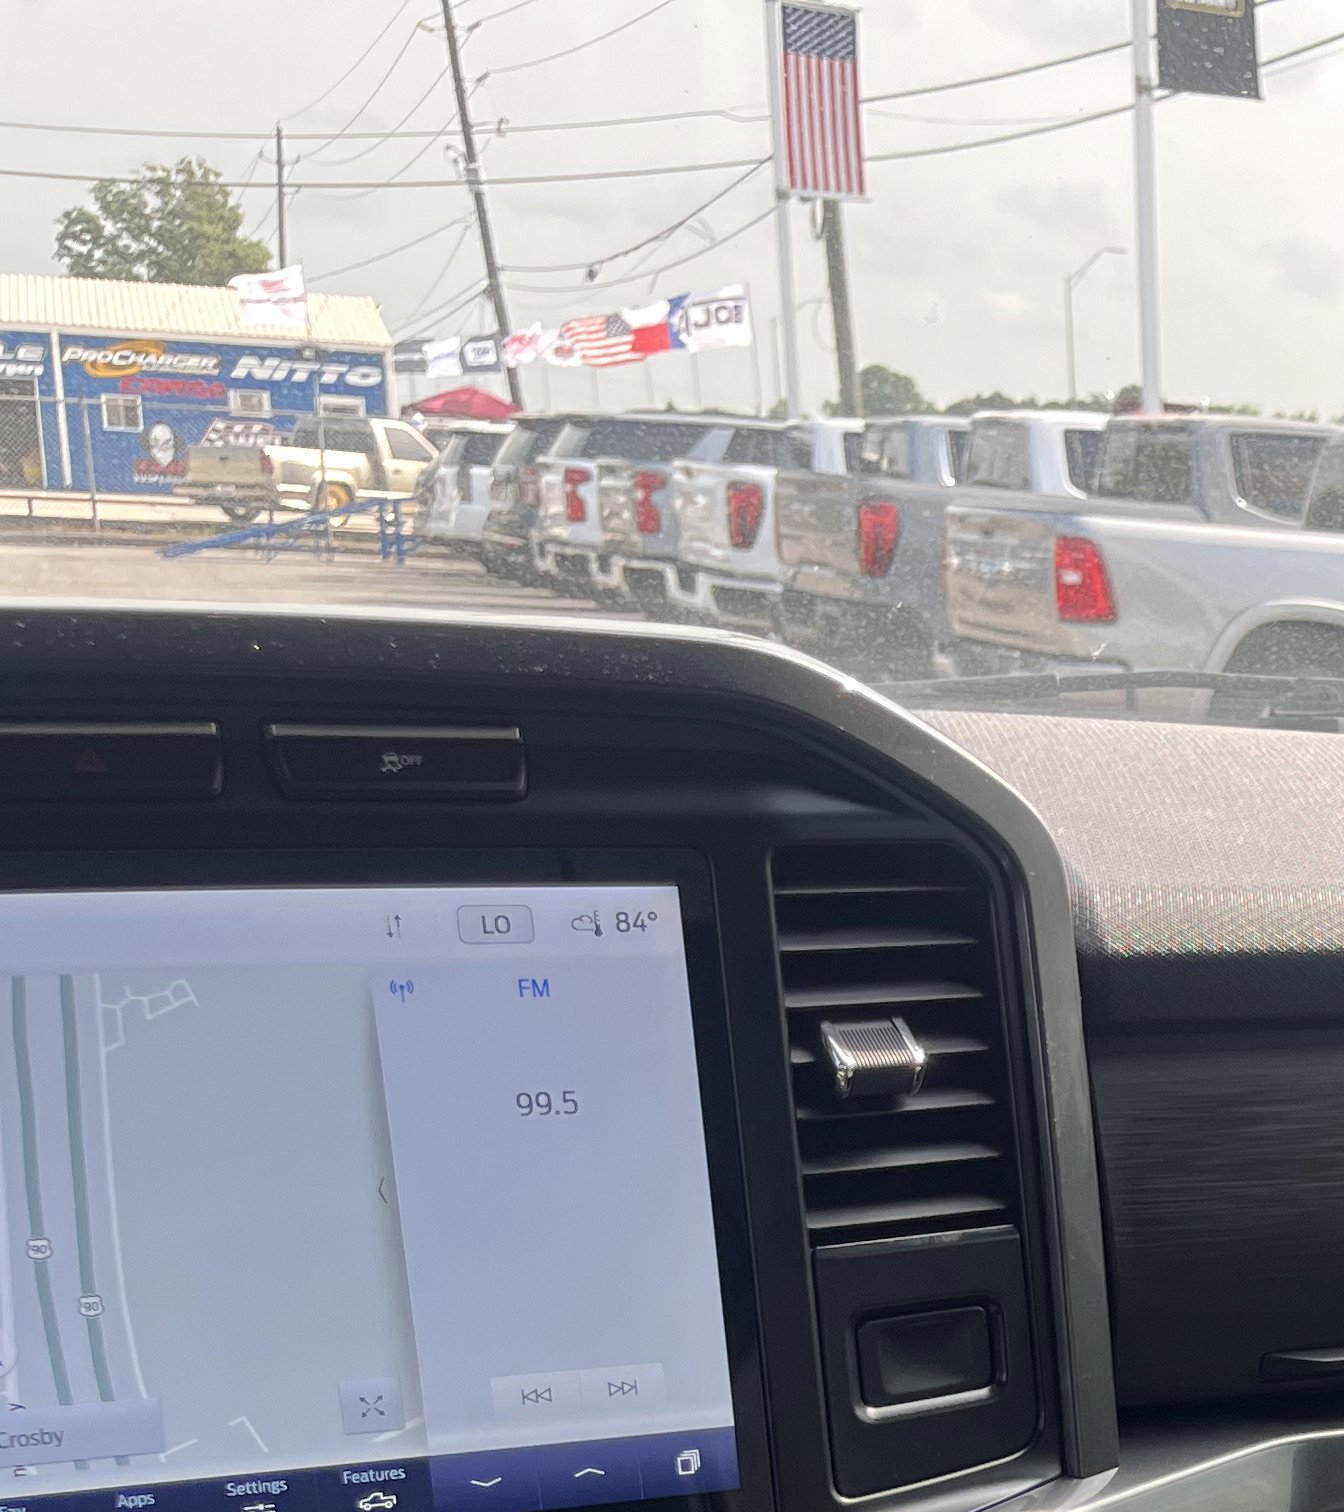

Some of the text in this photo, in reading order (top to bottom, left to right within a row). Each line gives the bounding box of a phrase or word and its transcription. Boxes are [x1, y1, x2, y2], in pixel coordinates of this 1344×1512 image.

[231, 355, 383, 387] NITTO
[481, 911, 658, 936] LO 84°
[519, 979, 551, 998] FM
[516, 1091, 579, 1117] 99.5
[30, 1243, 47, 1256] 90
[83, 1300, 99, 1313] 90
[0, 1427, 64, 1449] Crosby
[342, 1465, 406, 1486] Features
[226, 1477, 288, 1498] Settings
[117, 1491, 155, 1512] Apps
